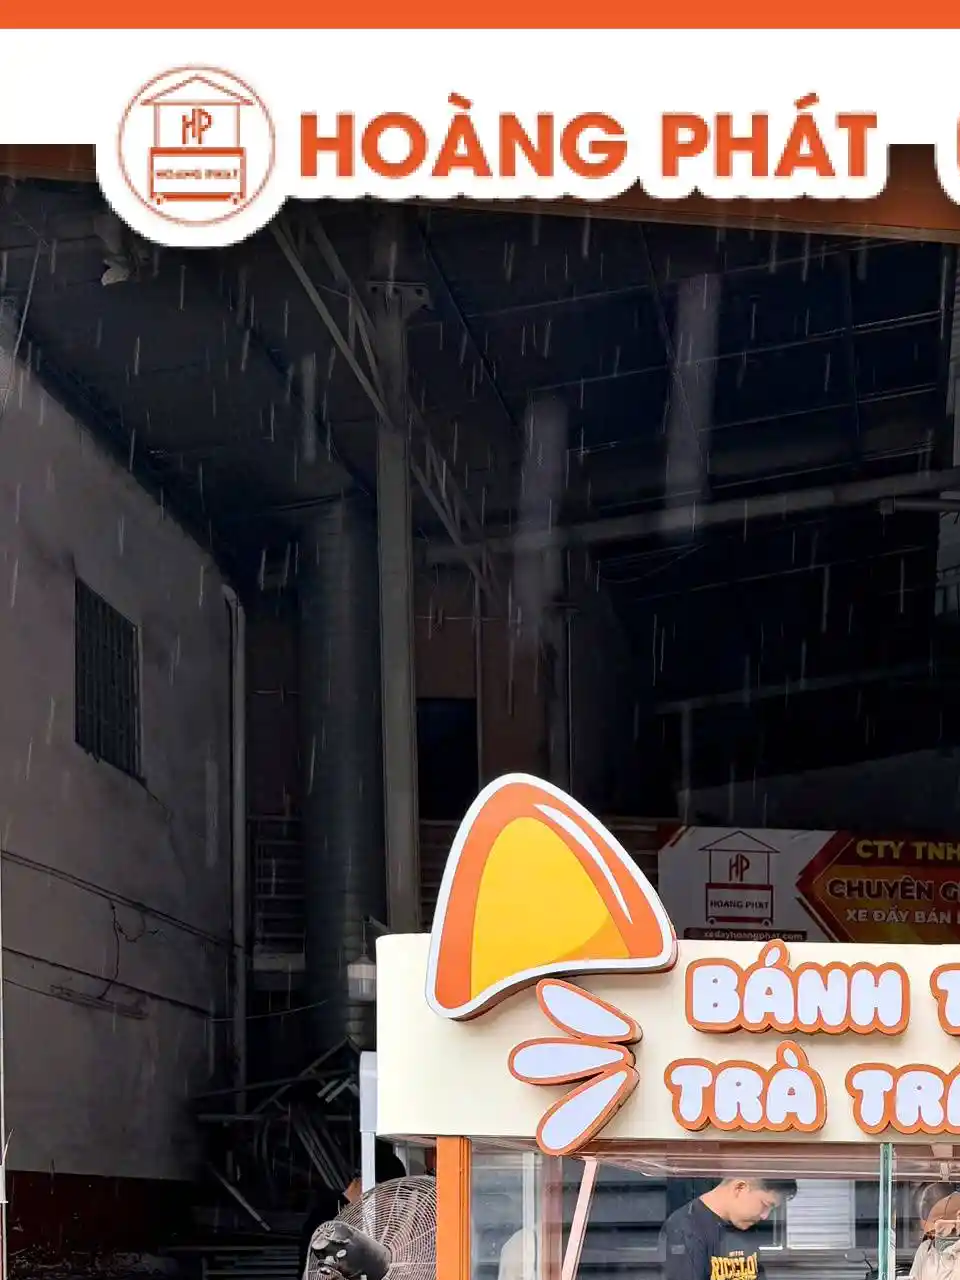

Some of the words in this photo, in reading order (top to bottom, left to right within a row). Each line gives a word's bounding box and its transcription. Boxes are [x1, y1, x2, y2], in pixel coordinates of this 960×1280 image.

[857, 839, 903, 859] CTY
[826, 876, 934, 902] CHUYÊN
[846, 909, 869, 922] XE
[914, 908, 951, 925] BÁN
[688, 942, 906, 1030] BÁNH
[667, 1043, 824, 1131] TRÀ
